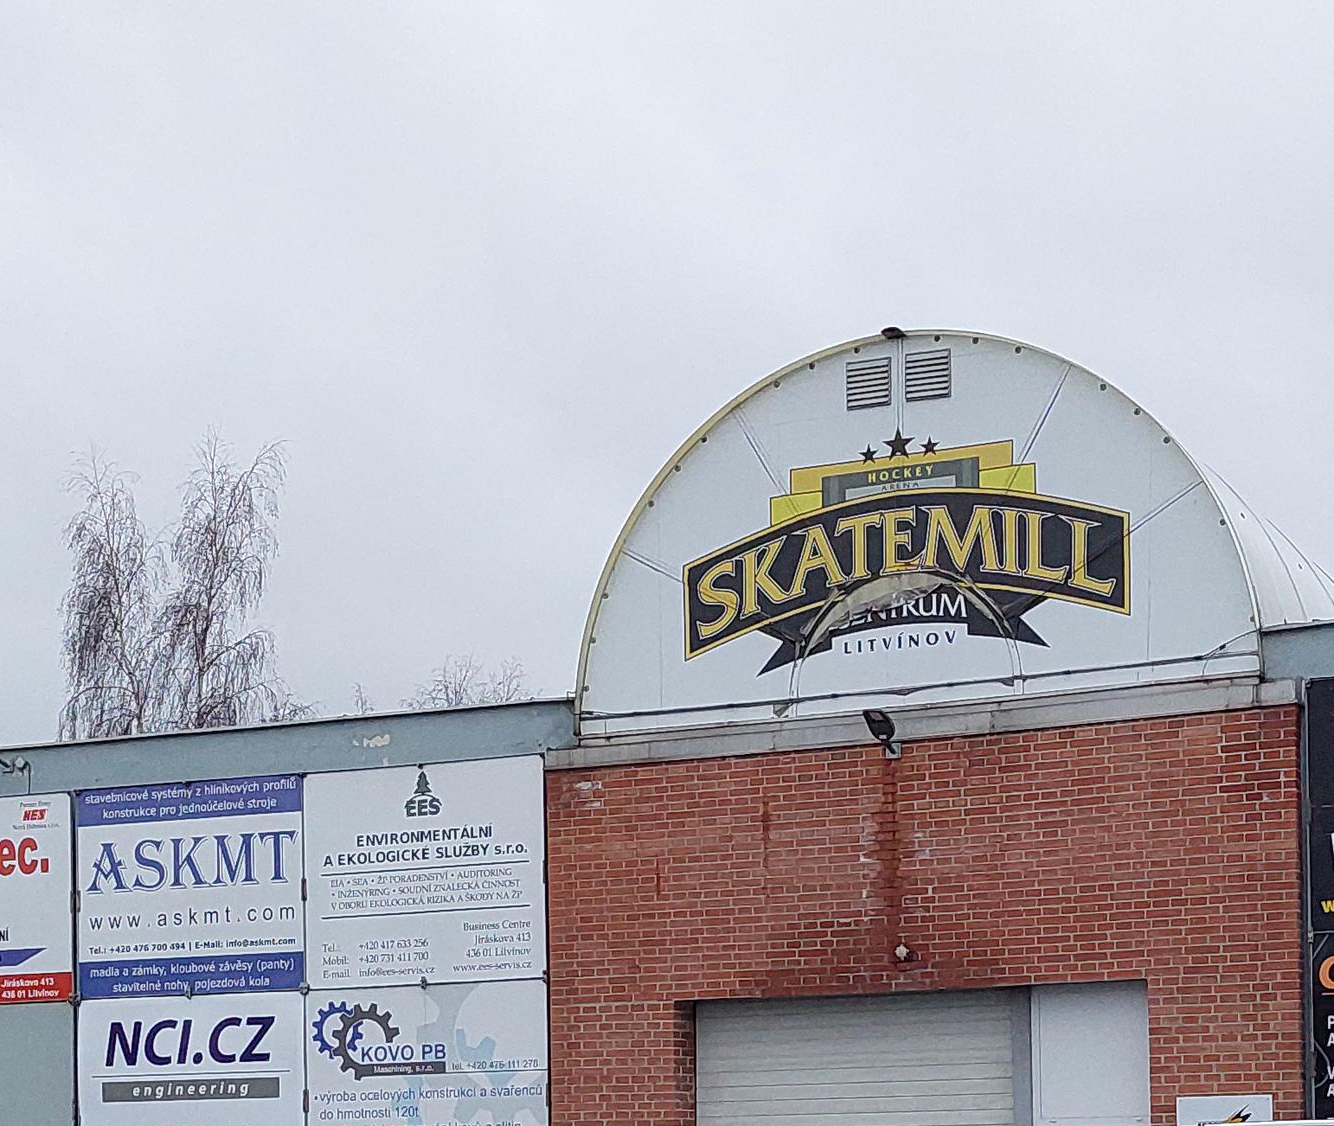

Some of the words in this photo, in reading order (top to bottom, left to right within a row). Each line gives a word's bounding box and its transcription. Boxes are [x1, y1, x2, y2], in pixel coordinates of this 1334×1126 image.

[868, 465, 934, 484] HOCKEY
[696, 503, 1116, 639] SKATEMILL
[844, 630, 956, 655] LITVÍNOV
[85, 789, 148, 804] stavebnicové
[151, 786, 192, 802] systémy
[195, 787, 201, 796] z
[204, 781, 260, 796] hliníkových
[263, 777, 296, 792] profilů
[103, 807, 156, 819] konstrukce
[159, 806, 176, 817] pro
[178, 800, 244, 816] jednoúčelové
[247, 798, 277, 808] stroje
[405, 798, 442, 818] EES
[356, 823, 493, 847] ENVIRONMENTÁLNÍ
[86, 830, 299, 895] ASKMT
[323, 855, 334, 867] A
[338, 846, 430, 867] EKOLOGICKÉ
[435, 843, 489, 860] SLUŽBY
[494, 843, 528, 856] s.r.o.
[457, 868, 512, 880] AUDITORING
[398, 882, 432, 894] SOUDNÍ
[433, 880, 479, 892] ZNALECKÁ
[481, 877, 520, 889] ČINNOST
[369, 896, 425, 908] EKOLOGICKÁ
[427, 895, 455, 904] RIZIKA
[457, 895, 465, 903] A
[496, 892, 510, 900] NA
[89, 906, 296, 931] www.askmt.com
[463, 921, 499, 931] Business
[501, 920, 531, 929] Centre
[109, 944, 131, 953] +420
[152, 943, 167, 952] 700
[225, 938, 296, 949] info@askmt.com
[475, 934, 514, 944] Jiráskova
[516, 933, 531, 942] 413
[323, 956, 349, 966] Mobil:
[466, 950, 481, 958] 436
[483, 949, 493, 957] 01
[495, 947, 531, 957] Litvínov
[90, 967, 120, 979] madla
[122, 968, 129, 977] a
[170, 960, 216, 974] kloubové
[219, 958, 254, 973] závěsy
[256, 958, 295, 972] (panty)
[112, 979, 161, 994] stavitelné
[195, 977, 245, 990] pojezdová
[248, 976, 270, 986] kola
[105, 1016, 276, 1067] NCI.CZ
[361, 1044, 414, 1062] KOVO
[421, 1044, 446, 1060] PB
[132, 1081, 250, 1099] engineering
[320, 1091, 356, 1104] výroba
[360, 1088, 416, 1102] ocelových
[419, 1086, 476, 1100] konstrukcí
[480, 1089, 487, 1097] a
[489, 1083, 543, 1097] svařenců
[319, 1109, 334, 1120] do
[336, 1107, 391, 1119] hmotnosti
[395, 1106, 419, 1118] 120t
